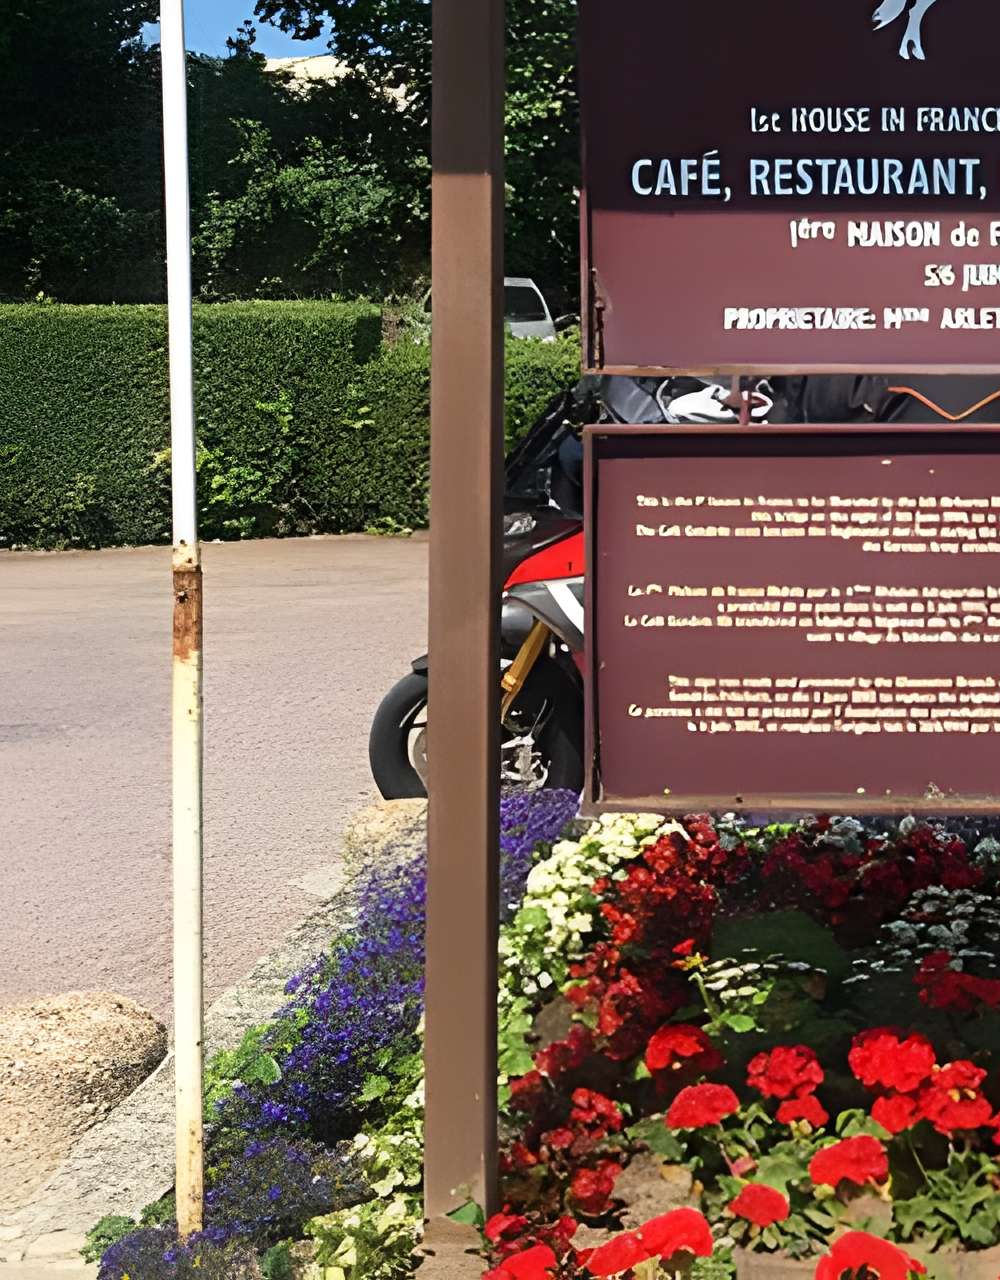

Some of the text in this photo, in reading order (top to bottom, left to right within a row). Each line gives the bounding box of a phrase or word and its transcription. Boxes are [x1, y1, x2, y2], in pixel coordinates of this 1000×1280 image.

[791, 107, 871, 133] HOUSE
[881, 106, 905, 132] IN
[631, 149, 732, 202] CAFÉ,
[749, 157, 987, 200] RESTAURANT,
[847, 220, 941, 248] MAISON
